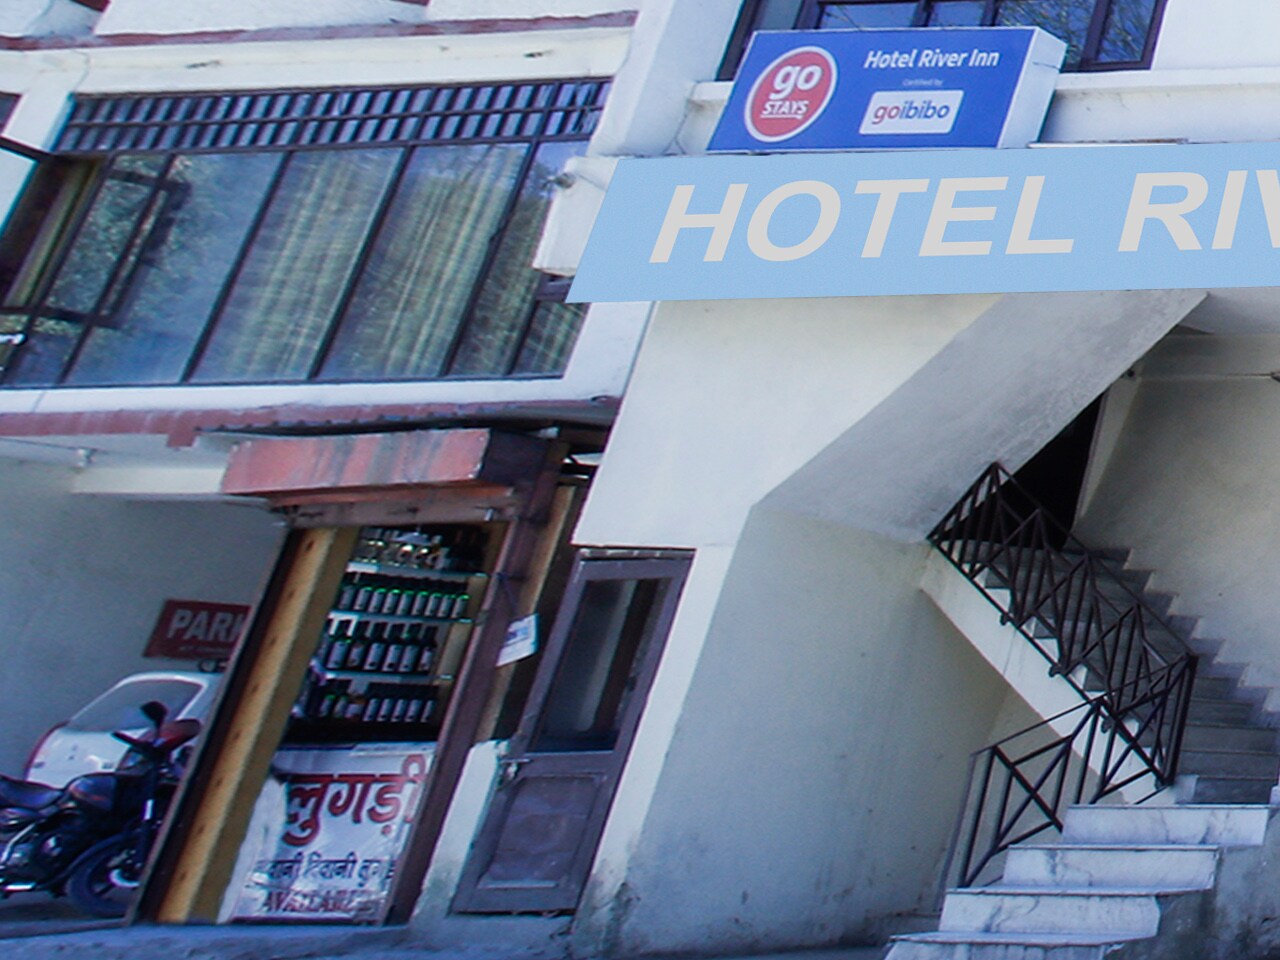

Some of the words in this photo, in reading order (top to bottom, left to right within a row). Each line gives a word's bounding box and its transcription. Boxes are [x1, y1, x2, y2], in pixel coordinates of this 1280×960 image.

[863, 48, 916, 69] Hotel
[917, 48, 968, 68] River
[968, 48, 1000, 67] Inn
[769, 62, 822, 101] go
[761, 99, 809, 116] STAYS
[872, 100, 950, 125] goibibo
[649, 175, 1075, 264] HOTEL
